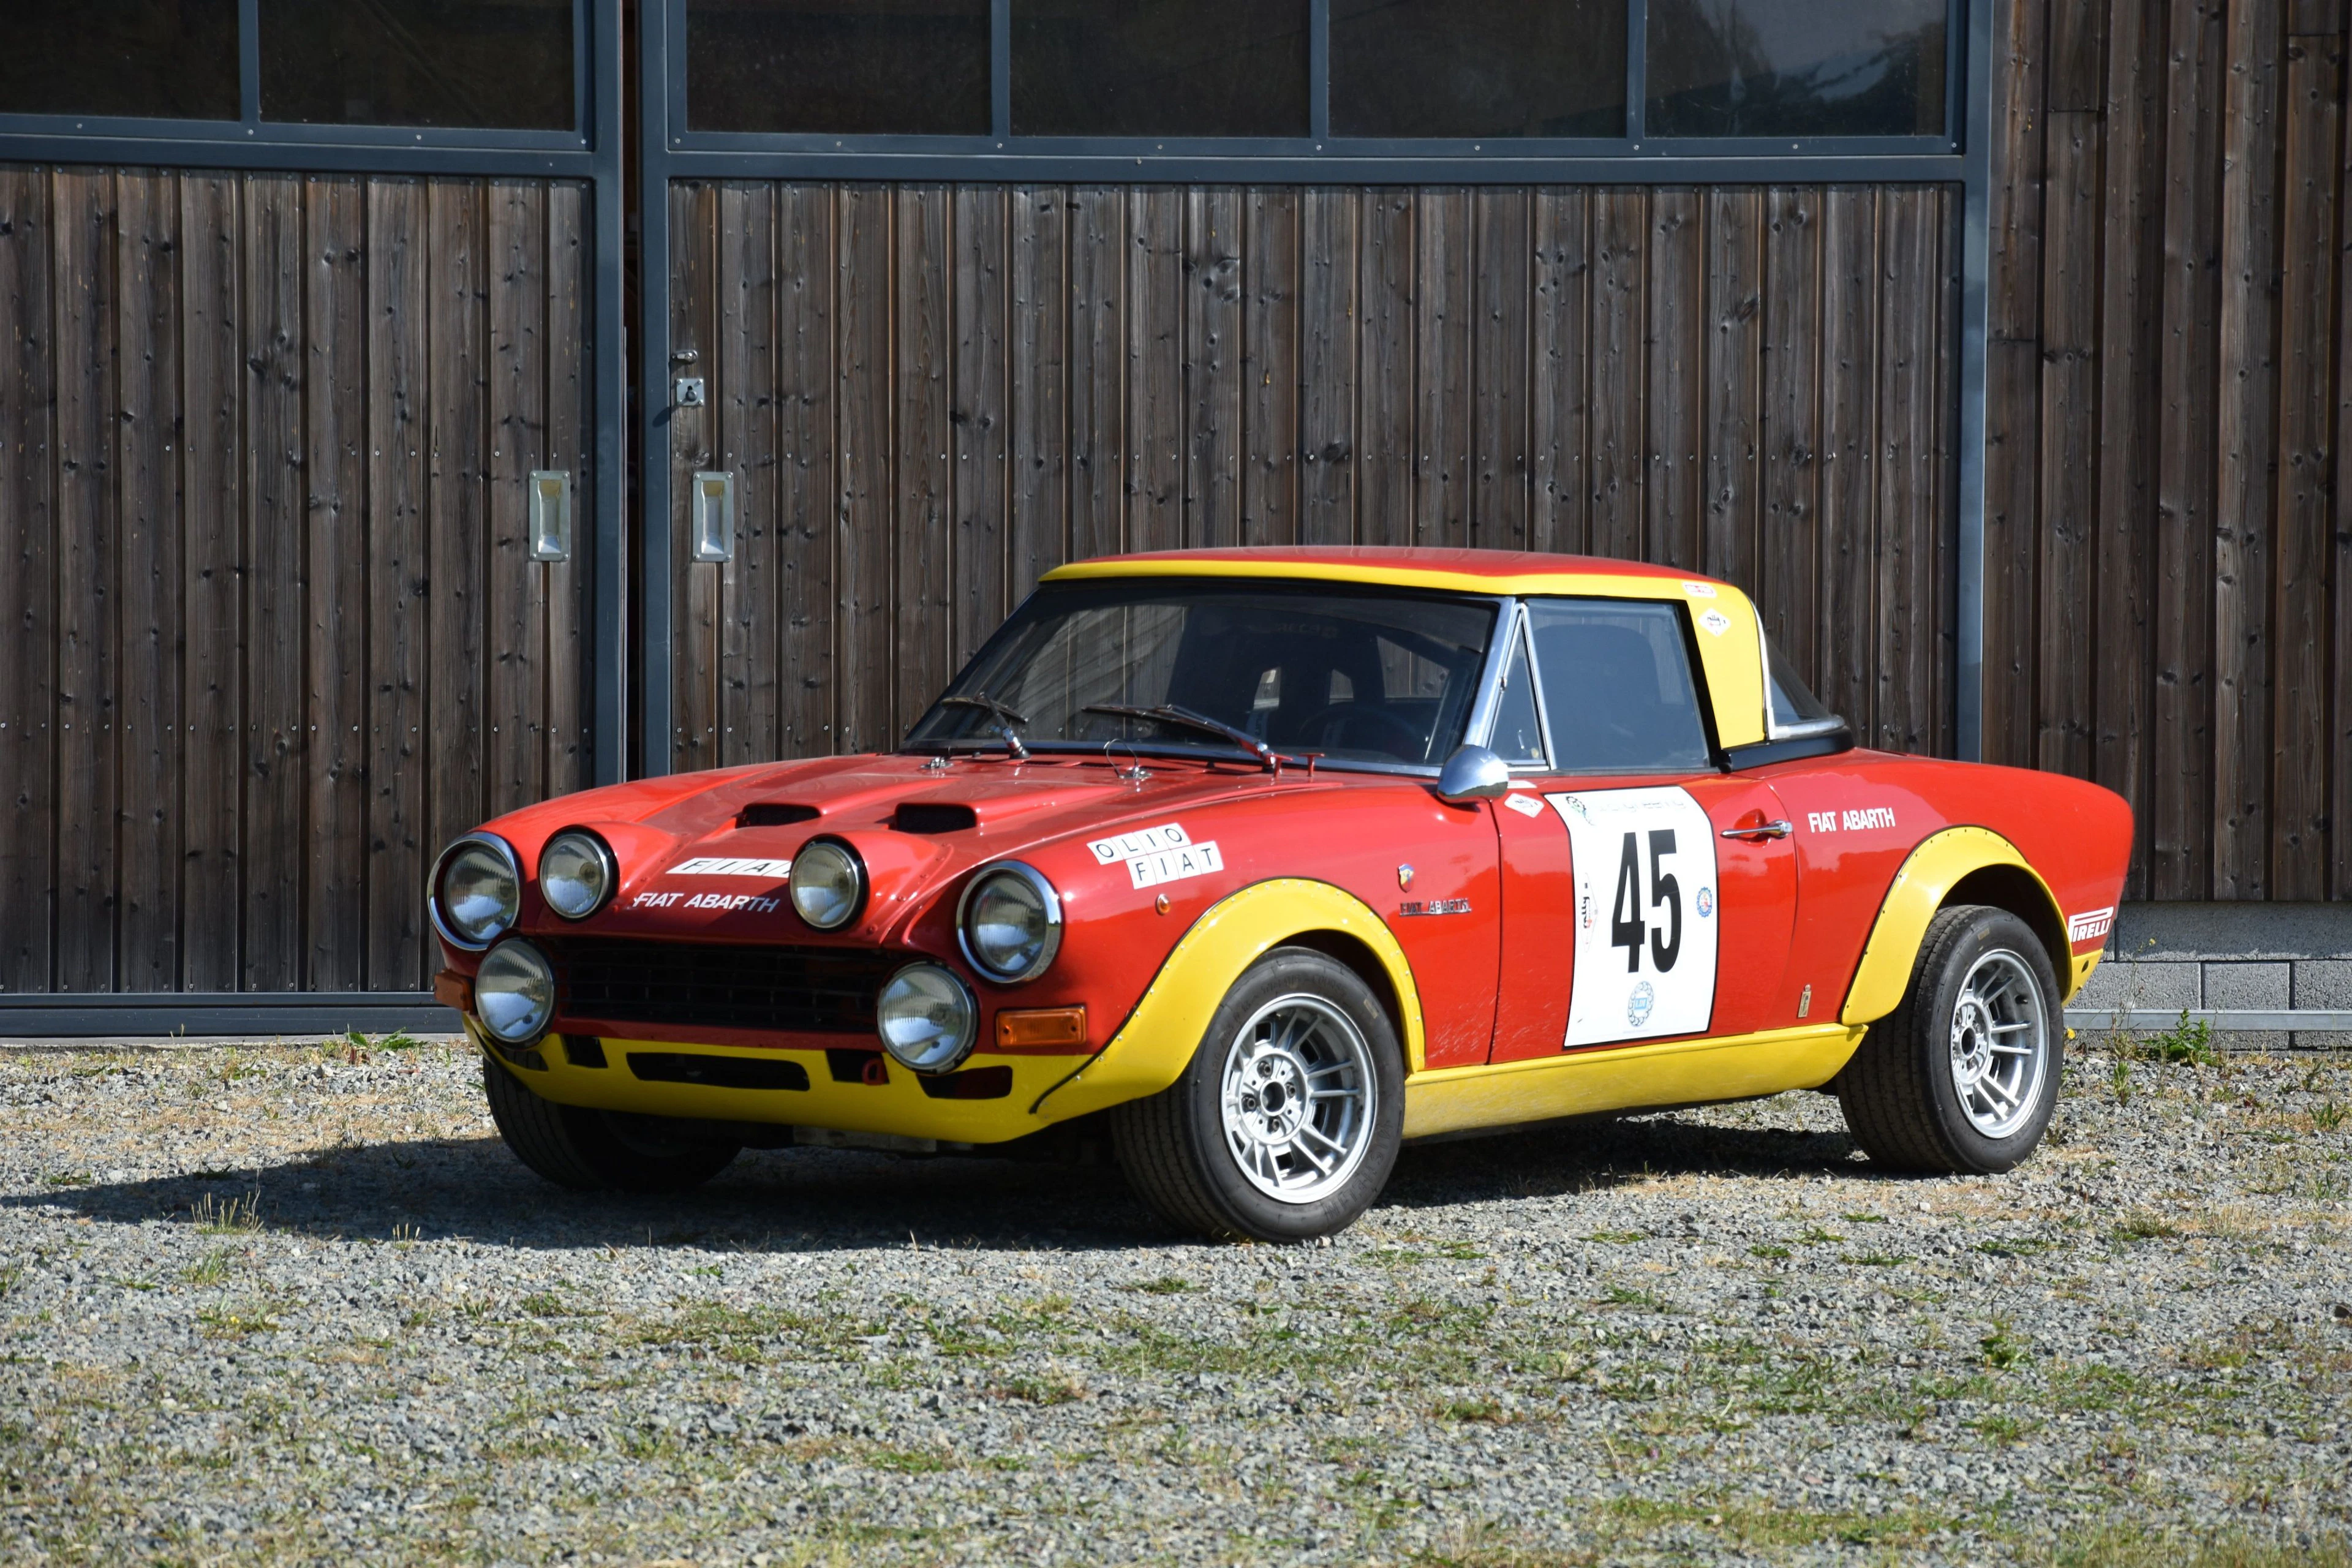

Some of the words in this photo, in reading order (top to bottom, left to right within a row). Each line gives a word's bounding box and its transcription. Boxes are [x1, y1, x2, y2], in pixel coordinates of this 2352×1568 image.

[1807, 812, 1837, 833] FIAT
[1842, 807, 1896, 831] ABARTH
[1096, 828, 1182, 858] OLIO
[682, 861, 790, 875] FIA
[1135, 848, 1211, 881] FIAT
[633, 893, 685, 907] FIAT
[684, 894, 780, 913] ABARTH
[1400, 902, 1423, 914] FIAT
[1428, 898, 1470, 914] ABARTH
[1611, 829, 1681, 973] 45
[2067, 906, 2114, 943] PIRELLI
